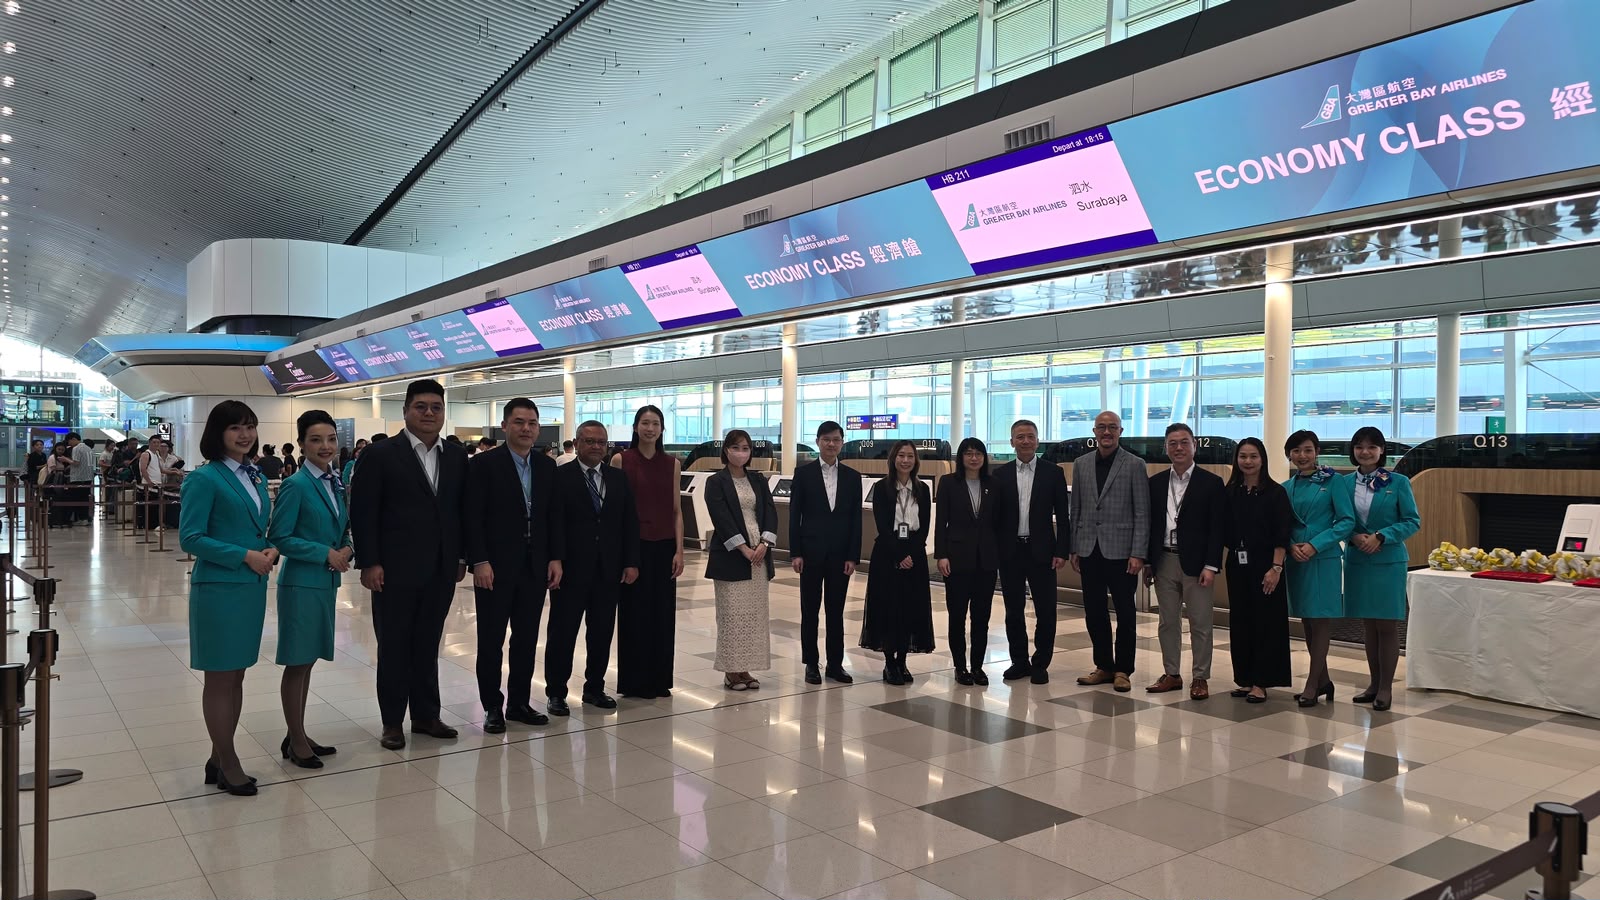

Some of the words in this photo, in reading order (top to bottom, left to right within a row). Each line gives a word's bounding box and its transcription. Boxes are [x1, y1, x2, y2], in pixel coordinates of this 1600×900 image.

[1345, 77, 1417, 104] 大灣區航空
[1347, 93, 1409, 116] GREATER
[1410, 85, 1437, 102] BAY
[1441, 69, 1508, 95] AIRLINES
[1052, 139, 1075, 153] Depart
[1076, 138, 1083, 147] at
[1084, 132, 1104, 145] 18:15
[1194, 133, 1367, 194] ECONOMY
[1378, 99, 1526, 155] CLASS
[941, 173, 955, 185] HB
[955, 169, 971, 182] 211
[1068, 180, 1093, 196] 泗水
[982, 212, 1017, 226] GREATER
[1017, 208, 1031, 219] BAY
[1033, 200, 1068, 215] AIRLINES
[1077, 193, 1128, 212] Surabaya
[868, 237, 923, 264] 經濟艙
[744, 262, 813, 290] ECONOMY
[813, 250, 866, 276] CLASS
[538, 314, 577, 331] ECONOMY
[574, 308, 604, 325] CLASS
[861, 440, 874, 448] Q09
[922, 440, 936, 448] Q10
[1474, 435, 1508, 448] Q13
